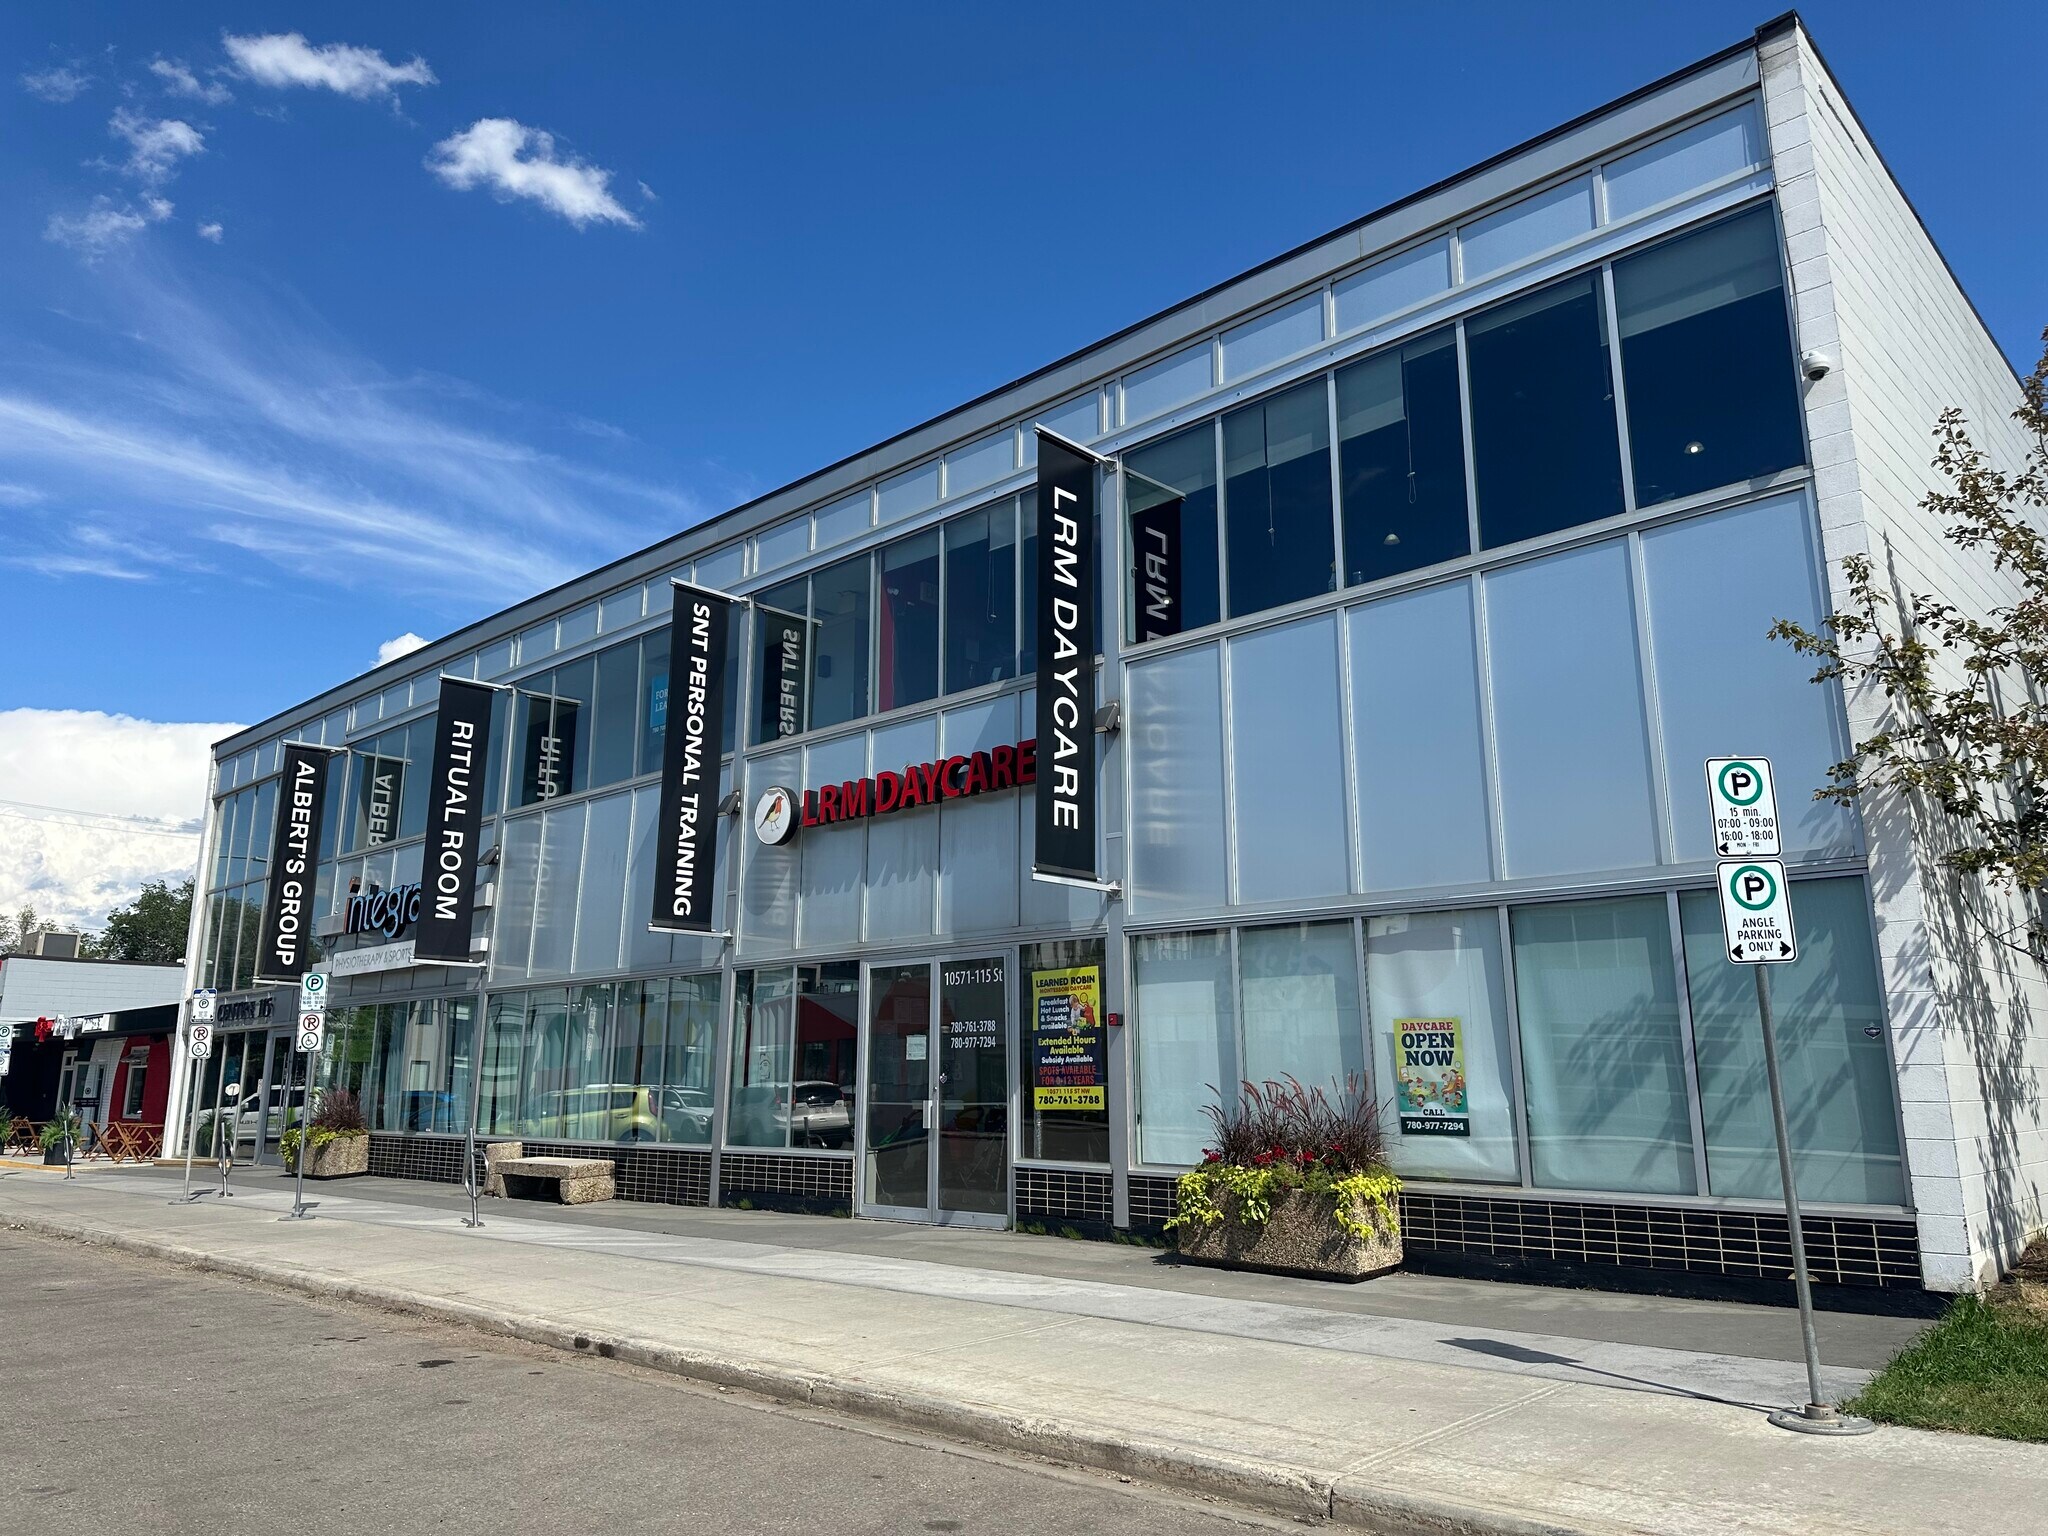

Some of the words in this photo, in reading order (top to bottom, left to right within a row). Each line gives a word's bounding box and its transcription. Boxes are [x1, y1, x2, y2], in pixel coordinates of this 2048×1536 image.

[1053, 486, 1078, 587] LRM
[691, 602, 711, 652] SNT
[1053, 597, 1079, 830] DAYCARE
[682, 655, 708, 786] PERSONAL
[444, 720, 474, 822] RITUAL
[803, 778, 868, 828] LRM
[875, 738, 1037, 815] DAYCARE
[285, 760, 316, 875] ALBERT'S
[1729, 807, 1738, 818] 15
[1742, 807, 1761, 817] min.
[1718, 818, 1741, 829] 07:00
[1749, 817, 1774, 828] 09:00
[1720, 831, 1743, 841] 16:00
[1751, 830, 1774, 840] 18:00
[672, 792, 699, 917] TRAINING
[434, 830, 464, 920] ROOM
[275, 881, 303, 966] GROUP
[1742, 917, 1775, 928] ANGLE
[1737, 928, 1782, 940] PARKING
[1748, 941, 1774, 952] ONLY
[335, 952, 383, 970] PHYSIOTHERAPY
[944, 969, 992, 986] 10571-115
[993, 968, 1003, 982] St
[1036, 977, 1069, 988] LEARNED
[1070, 975, 1095, 985] ROBIN
[1040, 998, 1068, 1006] Breakfast
[1046, 1014, 1067, 1022] Snacks
[950, 1020, 996, 1033] 780-761-3788
[1401, 1022, 1453, 1031] DAYCARE
[950, 1036, 996, 1049] 780-977-7294
[1037, 1036, 1072, 1046] Extended
[1073, 1036, 1096, 1045] Hours
[1401, 1032, 1455, 1049] OPEN
[1050, 1045, 1084, 1055] Available
[1041, 1056, 1064, 1065] Subsidy
[1065, 1054, 1093, 1063] Available
[1405, 1050, 1454, 1066] NOW
[1039, 1066, 1060, 1075] SPOTS
[1061, 1065, 1096, 1075] AVAILABLE
[1041, 1076, 1055, 1085] FOR
[1038, 1095, 1100, 1104] 780-761-3788
[1423, 1108, 1445, 1116] CALL
[1406, 1121, 1464, 1131] 780-977-7294
